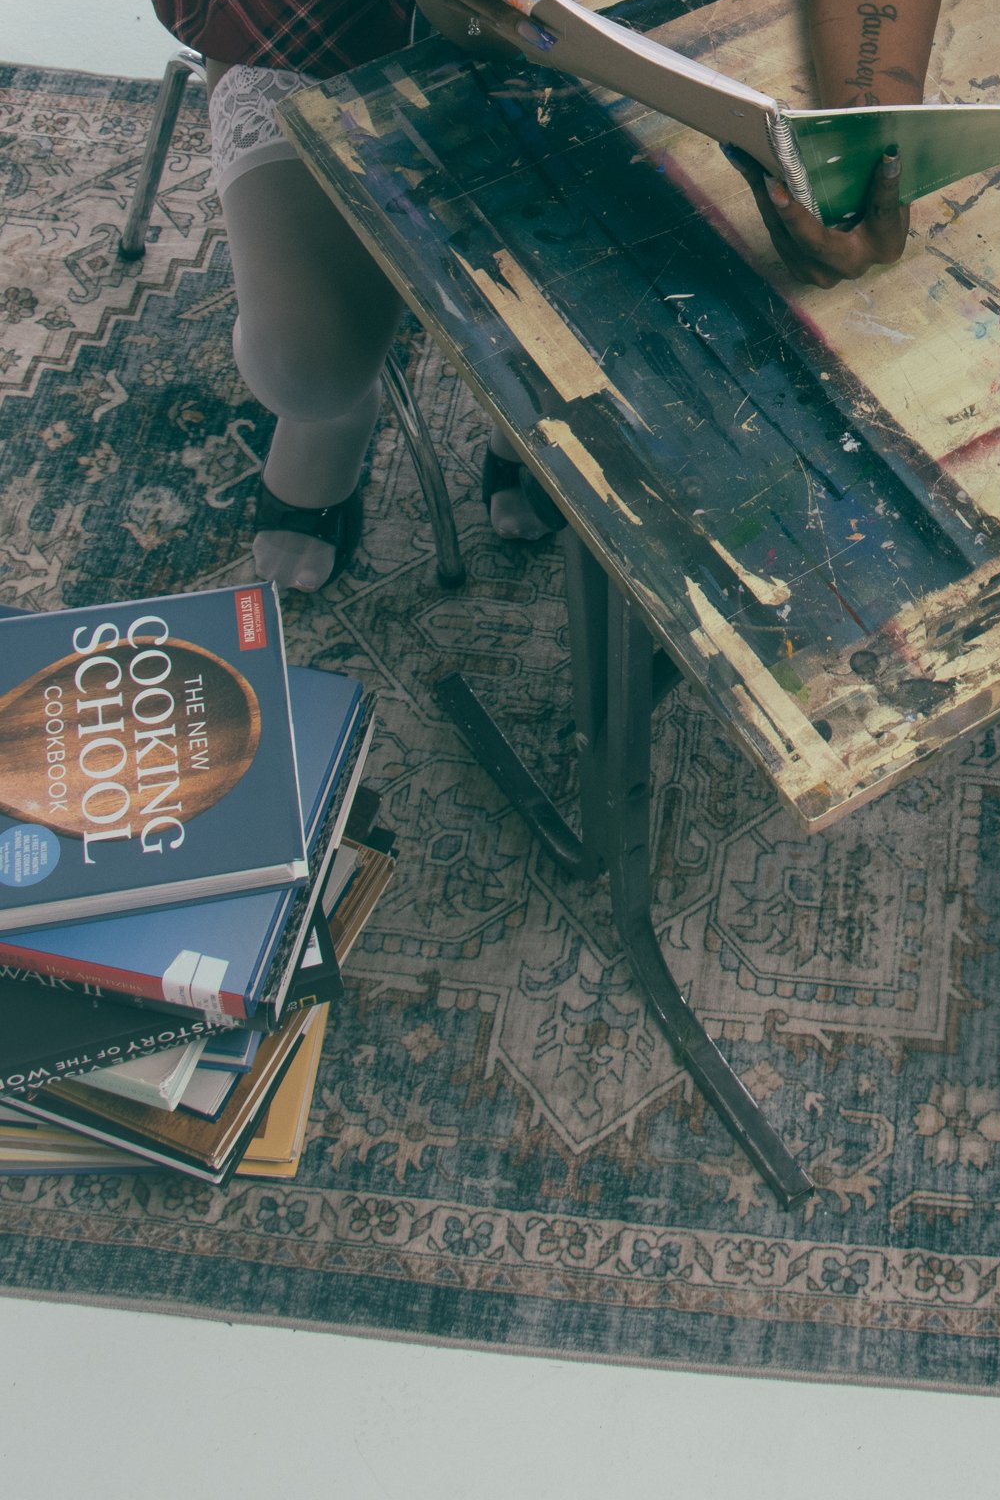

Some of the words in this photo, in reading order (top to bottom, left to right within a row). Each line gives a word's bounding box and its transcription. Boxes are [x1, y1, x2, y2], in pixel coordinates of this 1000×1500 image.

[240, 595, 253, 613] TEST
[242, 612, 256, 643] KITCHEN
[184, 674, 205, 716] THE
[44, 685, 68, 814] COOKBOOK
[72, 622, 132, 864] SCHOOL
[127, 615, 186, 854] COOKING
[187, 721, 210, 770] NEW
[55, 1055, 92, 1072] THE
[97, 1046, 121, 1060] OF
